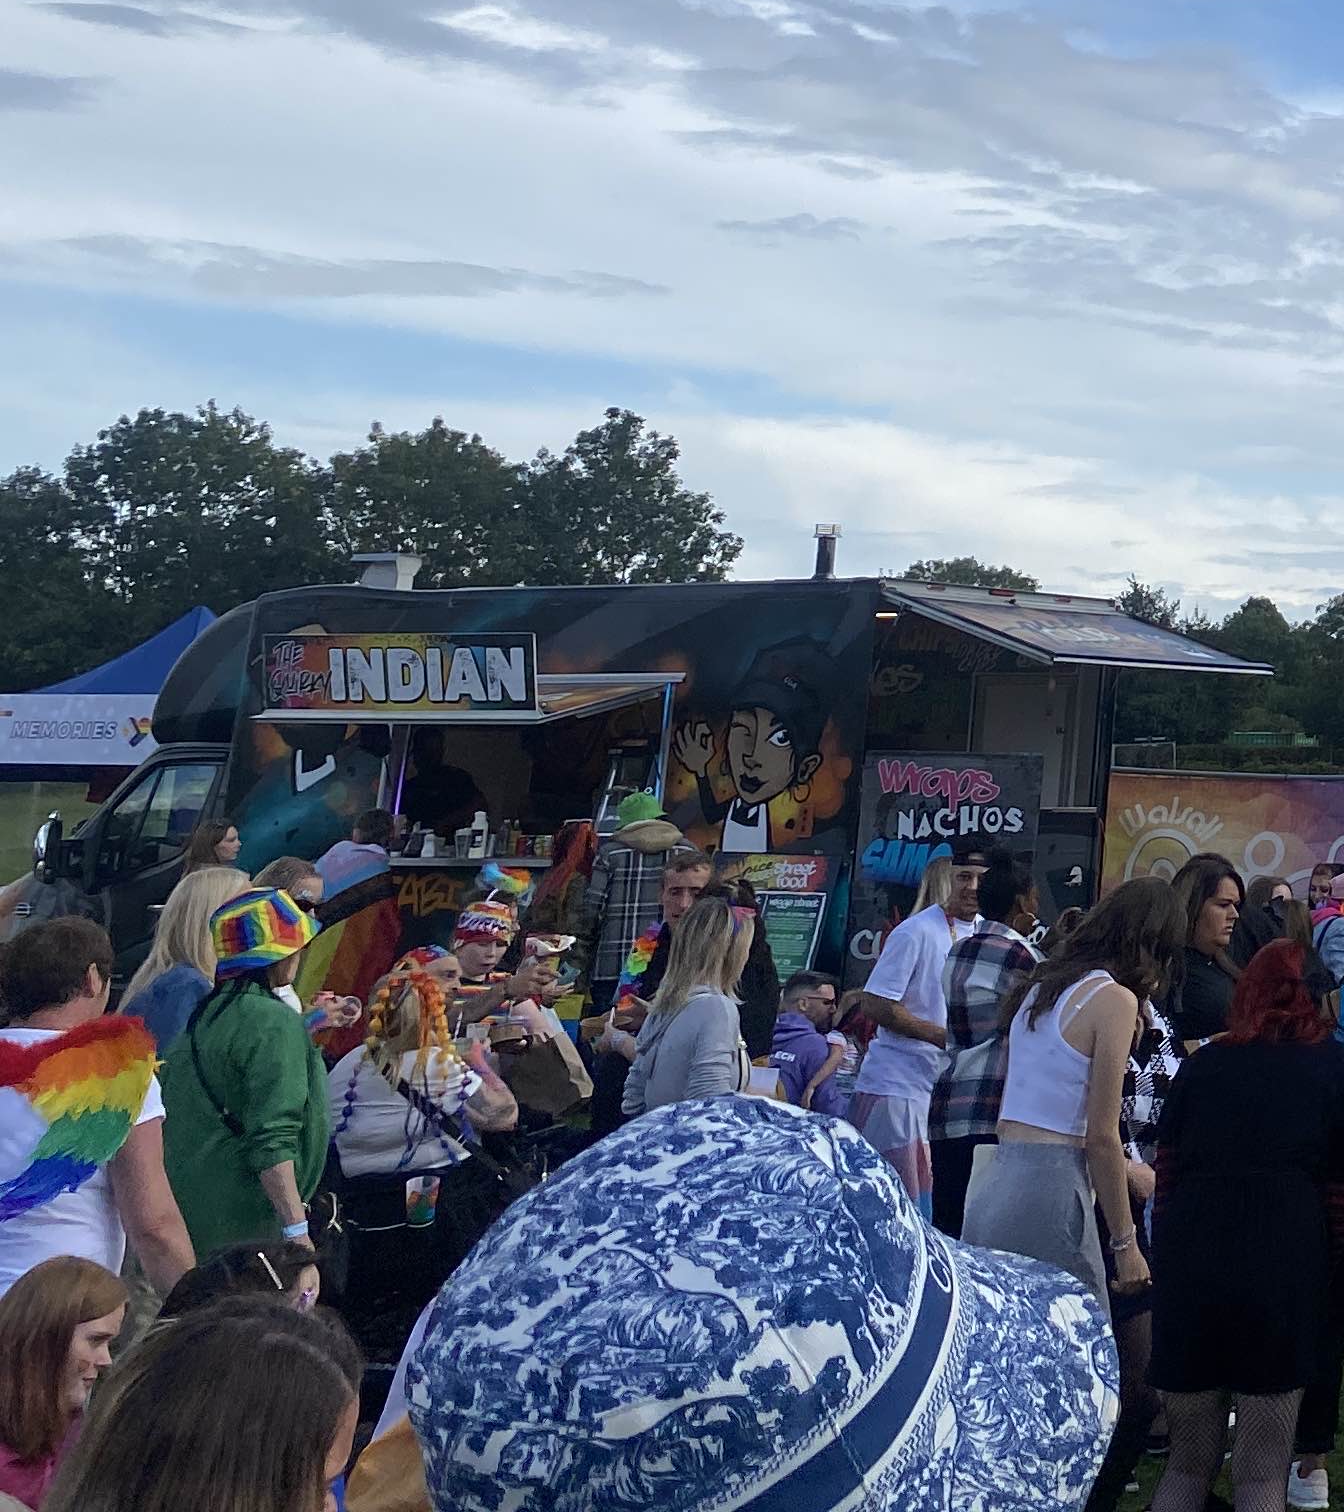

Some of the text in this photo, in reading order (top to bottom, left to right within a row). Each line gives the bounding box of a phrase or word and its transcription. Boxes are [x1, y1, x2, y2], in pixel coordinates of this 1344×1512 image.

[328, 647, 527, 701] INDIAN
[10, 720, 118, 740] MEMORIES
[897, 805, 1024, 839] NACHOS
[1118, 797, 1224, 840] Walsall
